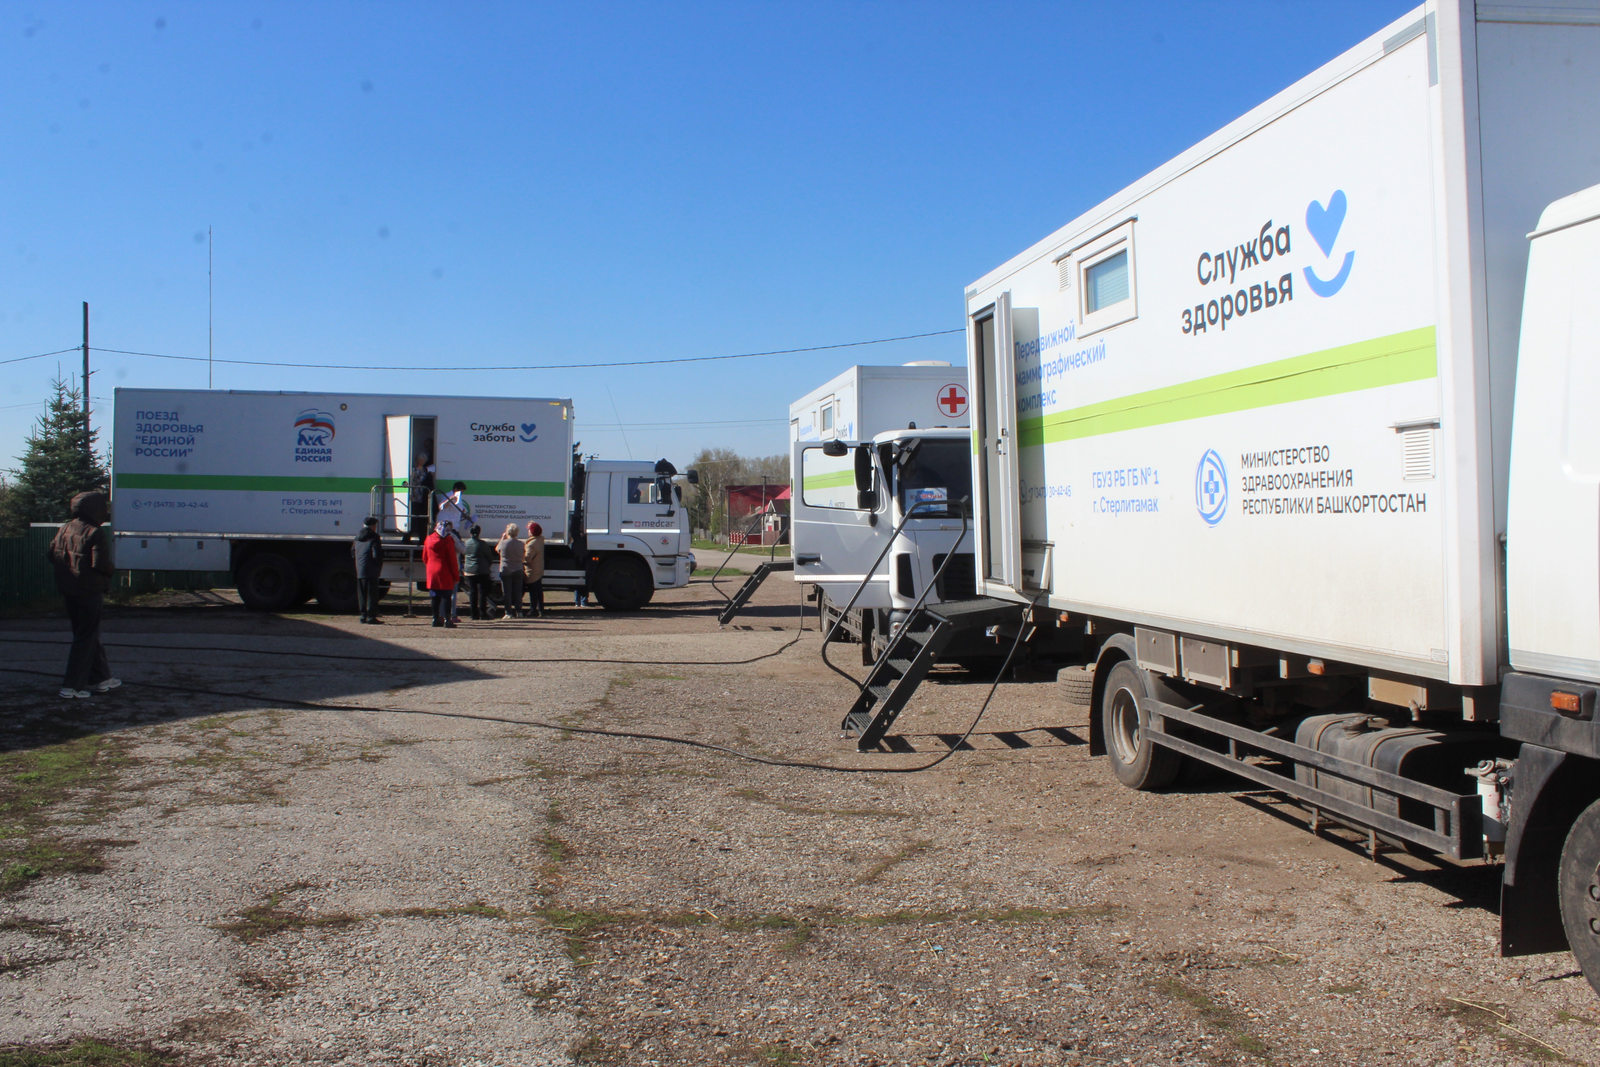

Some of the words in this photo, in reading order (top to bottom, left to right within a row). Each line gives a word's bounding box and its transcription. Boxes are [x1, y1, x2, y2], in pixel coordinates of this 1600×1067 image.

[1196, 218, 1292, 286] Служба
[1181, 272, 1294, 337] здоровья
[1014, 318, 1076, 363] Передвижной
[1016, 337, 1106, 386] маммографический
[1017, 389, 1057, 413] комплекс
[136, 410, 179, 422] ПОЕЗД
[136, 423, 204, 434] ЗДОРОВЬЯ
[470, 422, 516, 435] Служба
[473, 433, 516, 443] заботы
[295, 455, 332, 463] РОССИЯ
[1241, 444, 1331, 469] МИНИСТЕРСТВО
[1092, 470, 1113, 489] ГБУЗ
[1114, 469, 1126, 487] РБ
[1127, 468, 1139, 487] ГБ
[1242, 469, 1354, 493] ЗДРАВООХРАНЕНИЯ
[289, 507, 343, 515] Стерлитамак
[1100, 496, 1159, 518] Стерлитамак
[1242, 496, 1314, 515] РЕСПУБЛИКИ
[1316, 493, 1427, 514] БАШКОРТОСТАН
[641, 519, 675, 528] medcar
